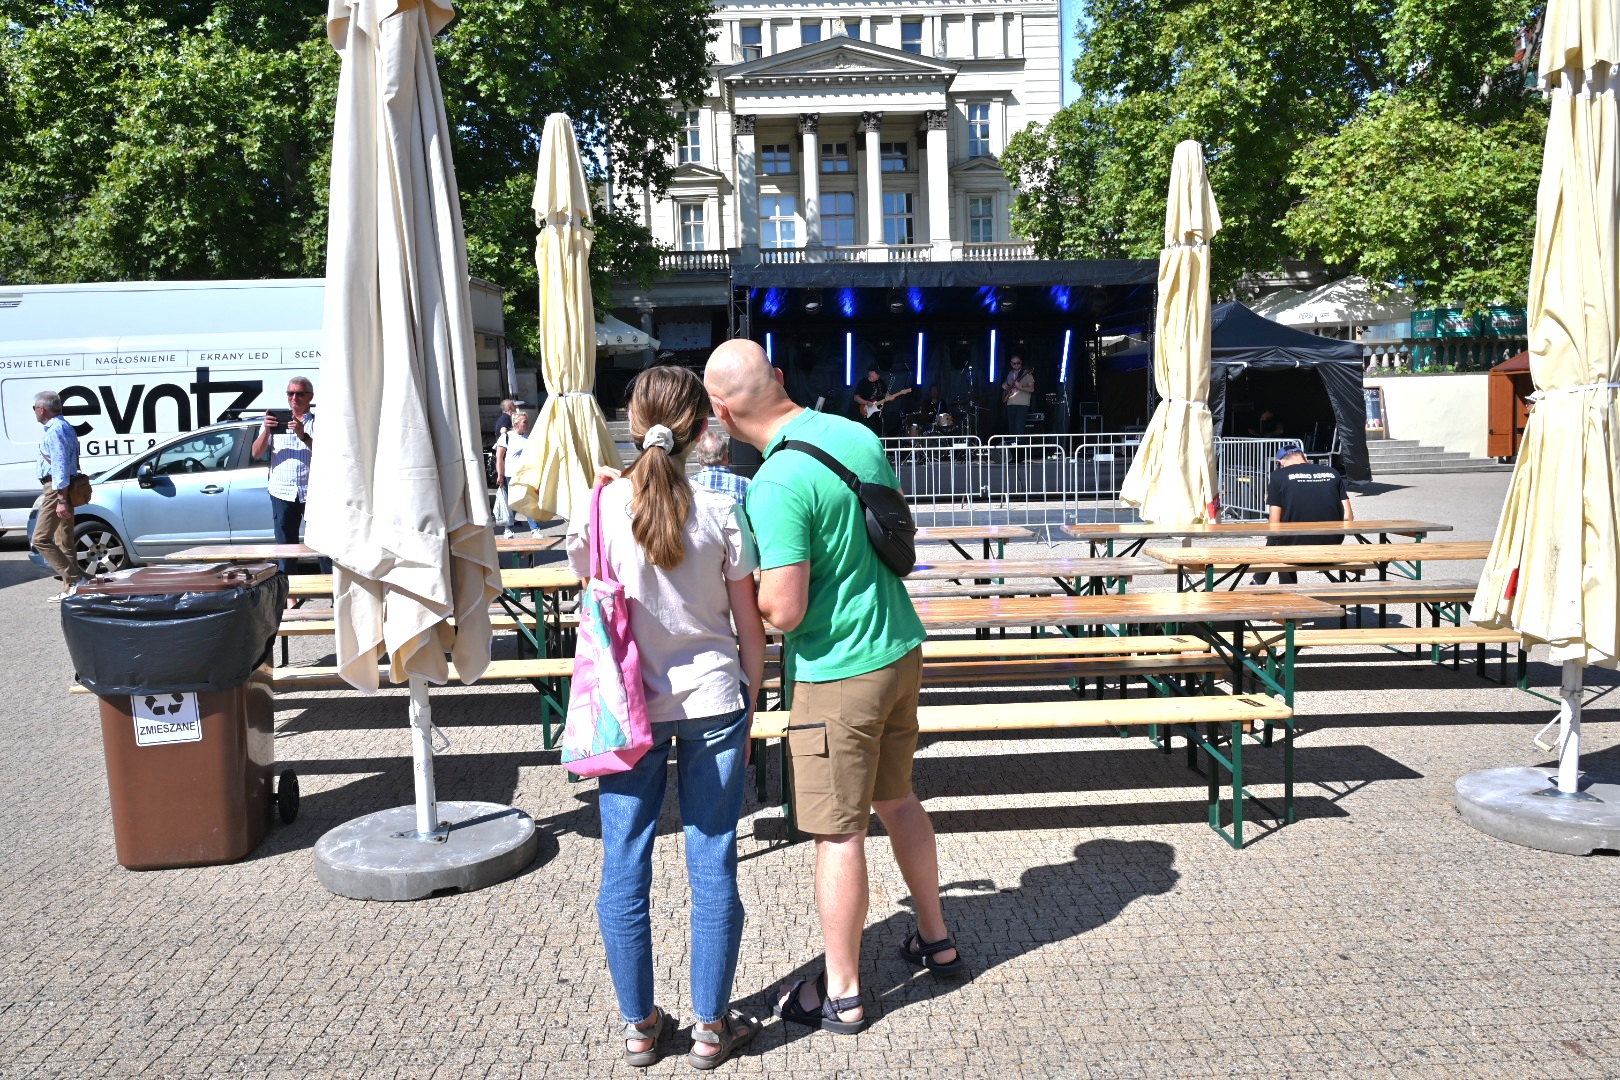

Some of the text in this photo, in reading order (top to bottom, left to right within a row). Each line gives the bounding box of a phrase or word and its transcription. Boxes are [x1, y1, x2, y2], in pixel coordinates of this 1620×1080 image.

[95, 354, 176, 365] NAGŁOŚNIENIE
[200, 352, 269, 361] EKRANY LED
[57, 367, 263, 437] evntz
[78, 439, 135, 456] IGHT
[140, 721, 196, 736] ZMIESZANE
